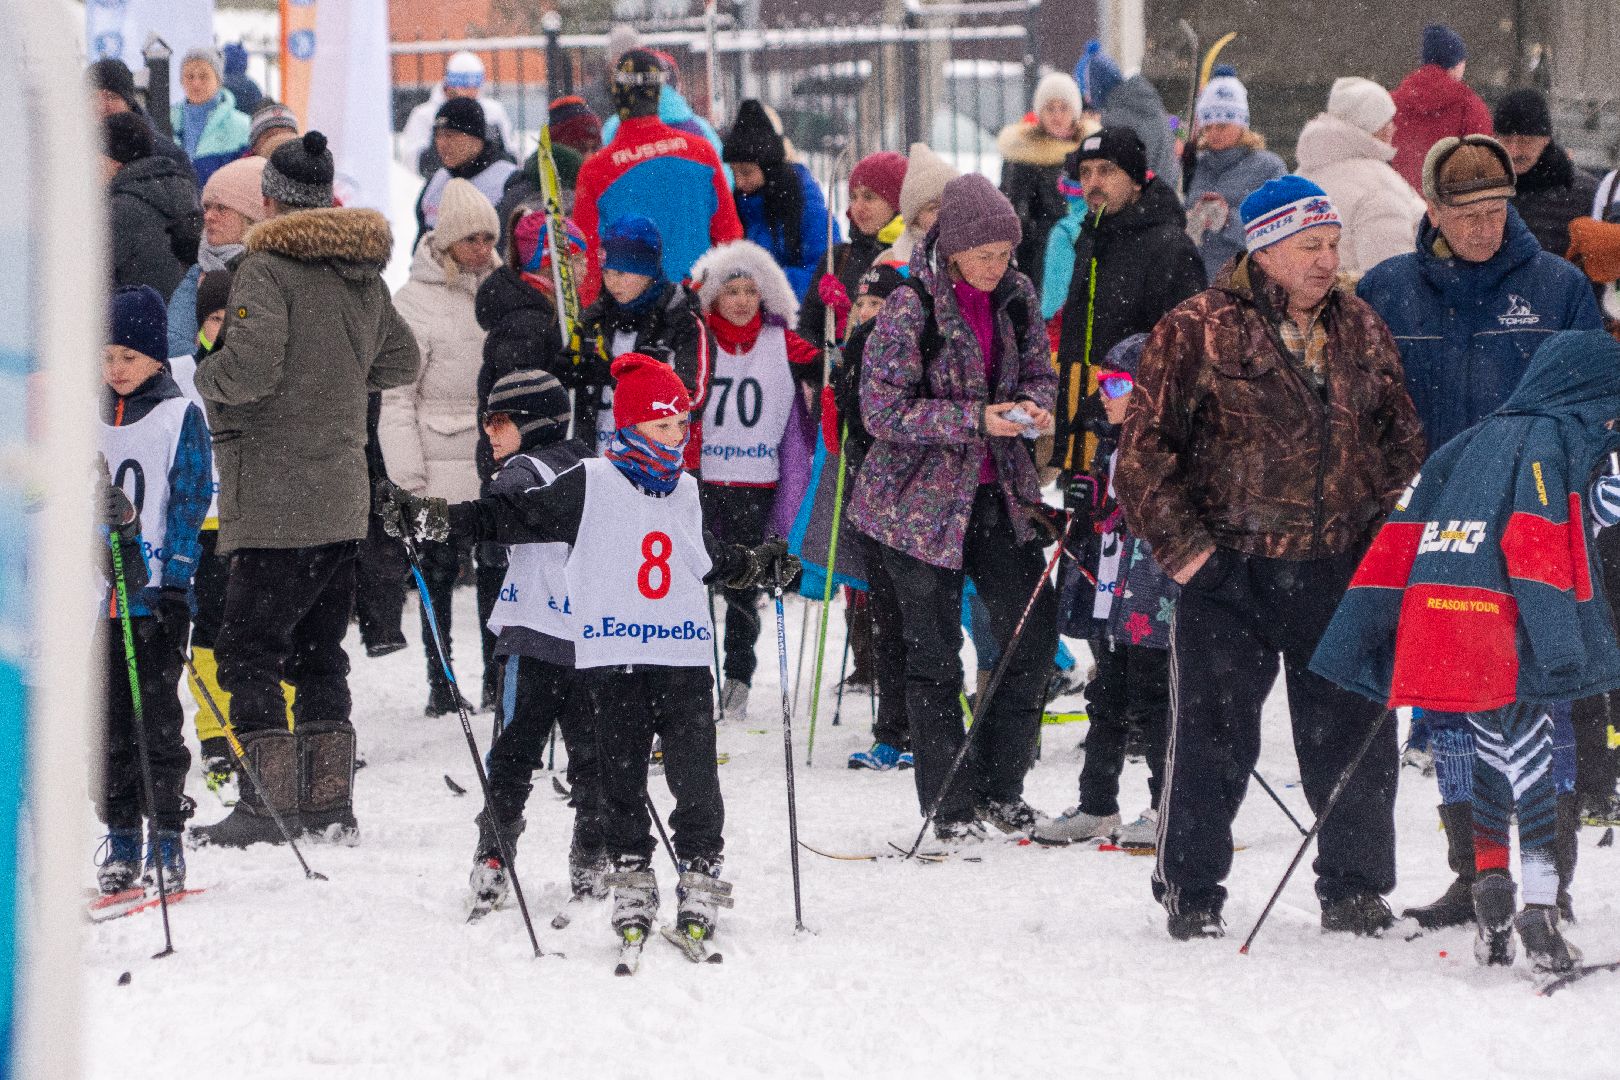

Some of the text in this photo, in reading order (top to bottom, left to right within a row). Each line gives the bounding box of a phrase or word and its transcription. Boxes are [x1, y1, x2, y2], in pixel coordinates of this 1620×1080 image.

[612, 137, 688, 166] RUSSIA
[712, 377, 763, 429] 70
[702, 441, 776, 461] горьевс
[637, 530, 673, 600] 8
